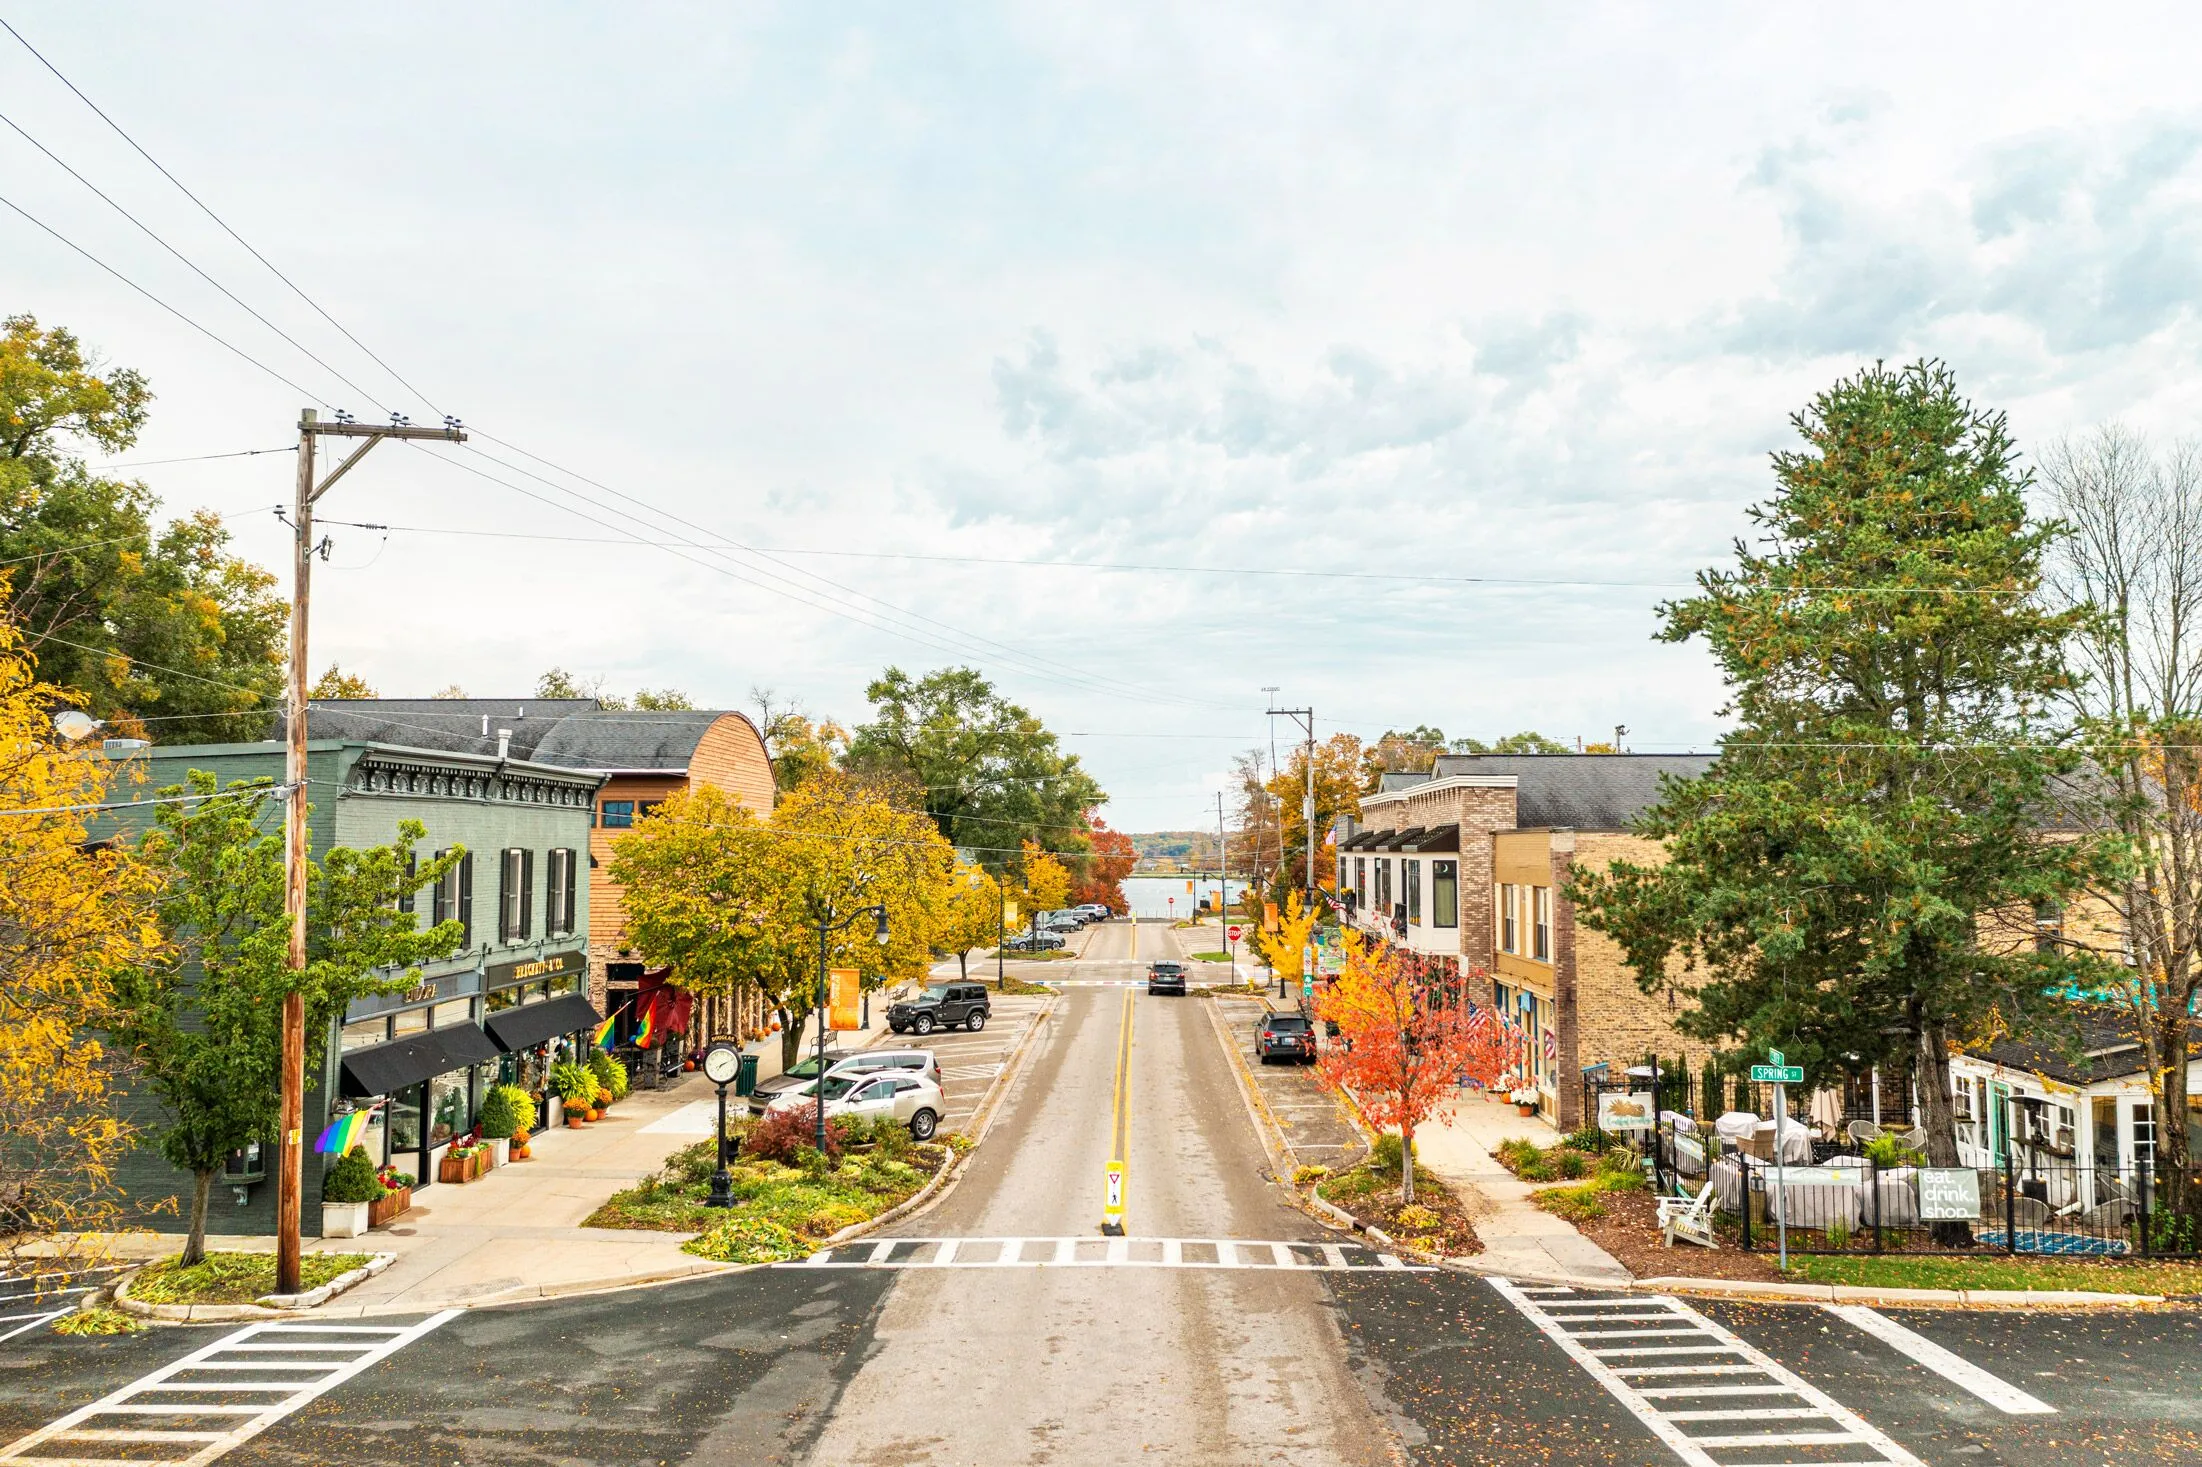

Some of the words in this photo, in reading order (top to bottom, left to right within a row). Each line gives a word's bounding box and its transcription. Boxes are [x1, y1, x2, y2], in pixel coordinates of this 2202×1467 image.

[1757, 1067, 1789, 1080] SPRING
[1923, 1170, 1956, 1184] eat.
[1924, 1184, 1975, 1202] drink.
